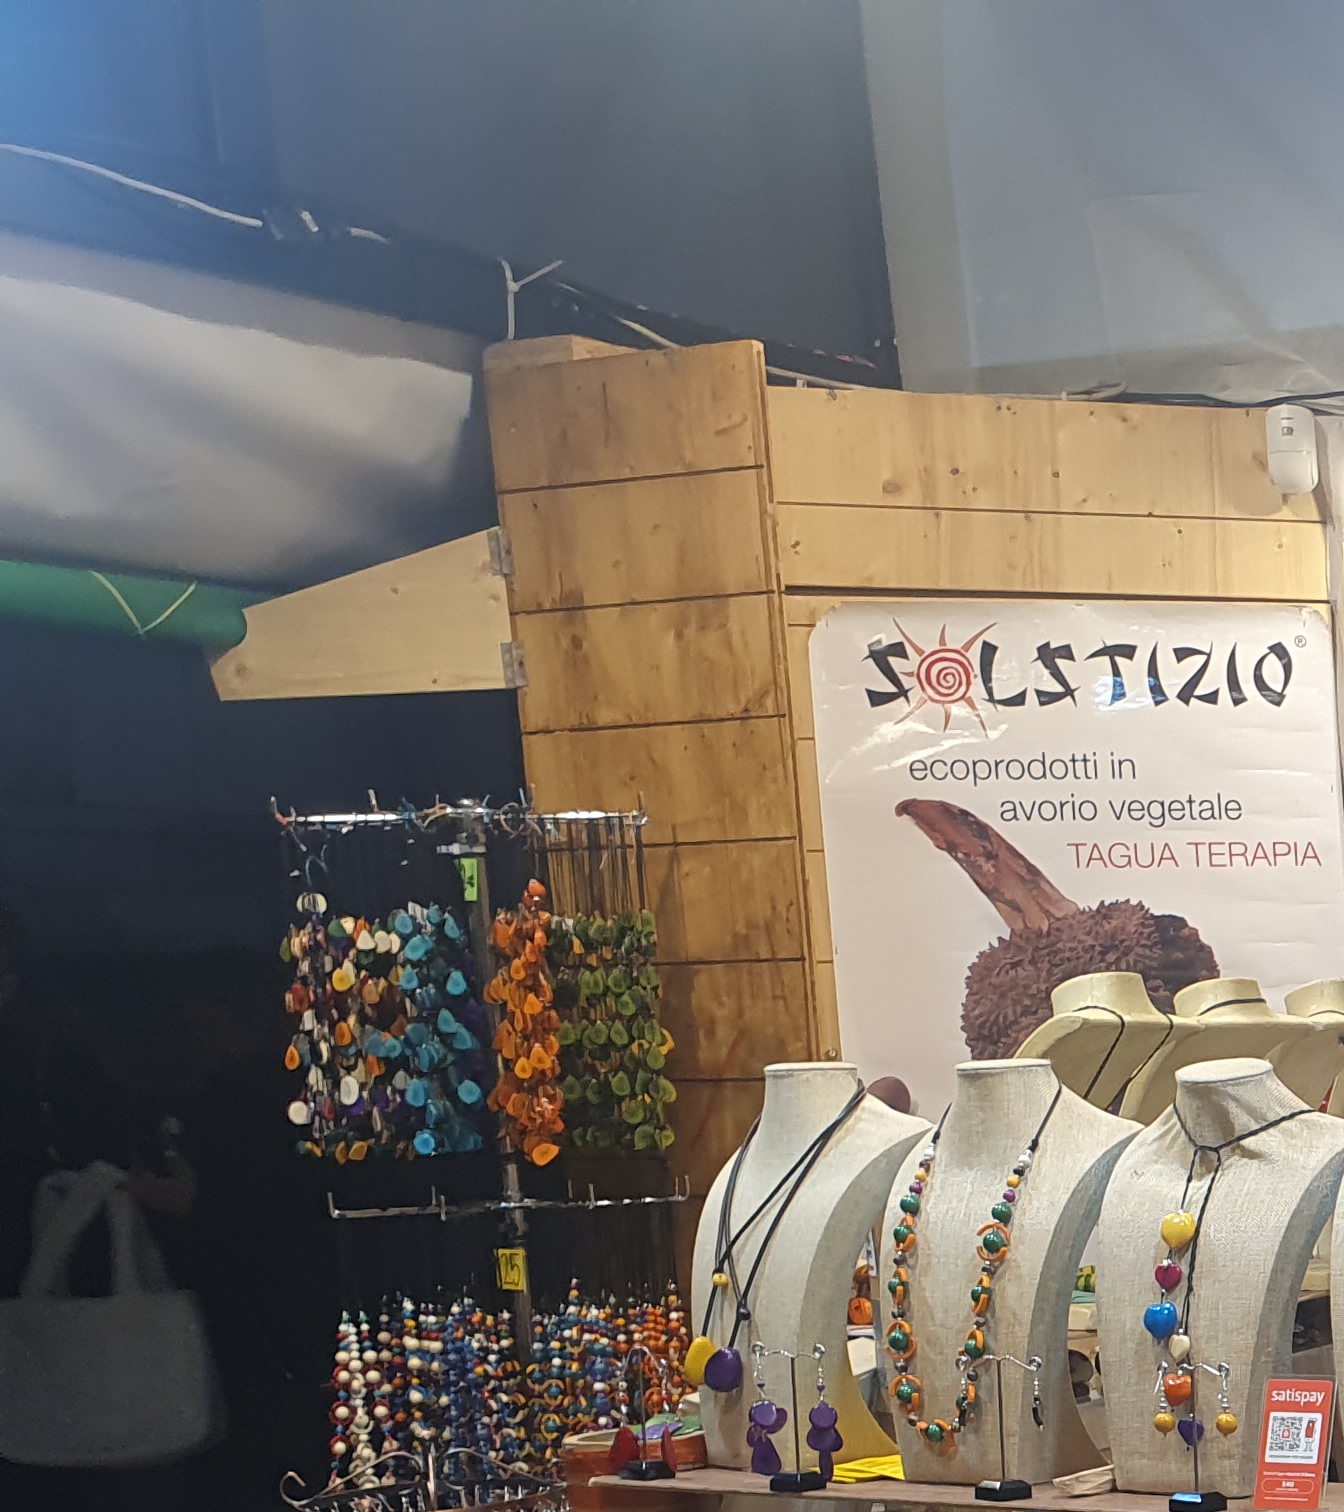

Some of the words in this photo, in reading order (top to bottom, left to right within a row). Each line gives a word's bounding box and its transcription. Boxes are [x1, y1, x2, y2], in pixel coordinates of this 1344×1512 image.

[909, 752, 1099, 787] ecoprodotti
[1110, 753, 1137, 780] in
[999, 795, 1099, 823] avorio
[1109, 793, 1243, 828] vegetale
[1067, 841, 1180, 870] TAGUA
[1186, 841, 1323, 869] TERAPIA
[1271, 1388, 1326, 1407] satispay
